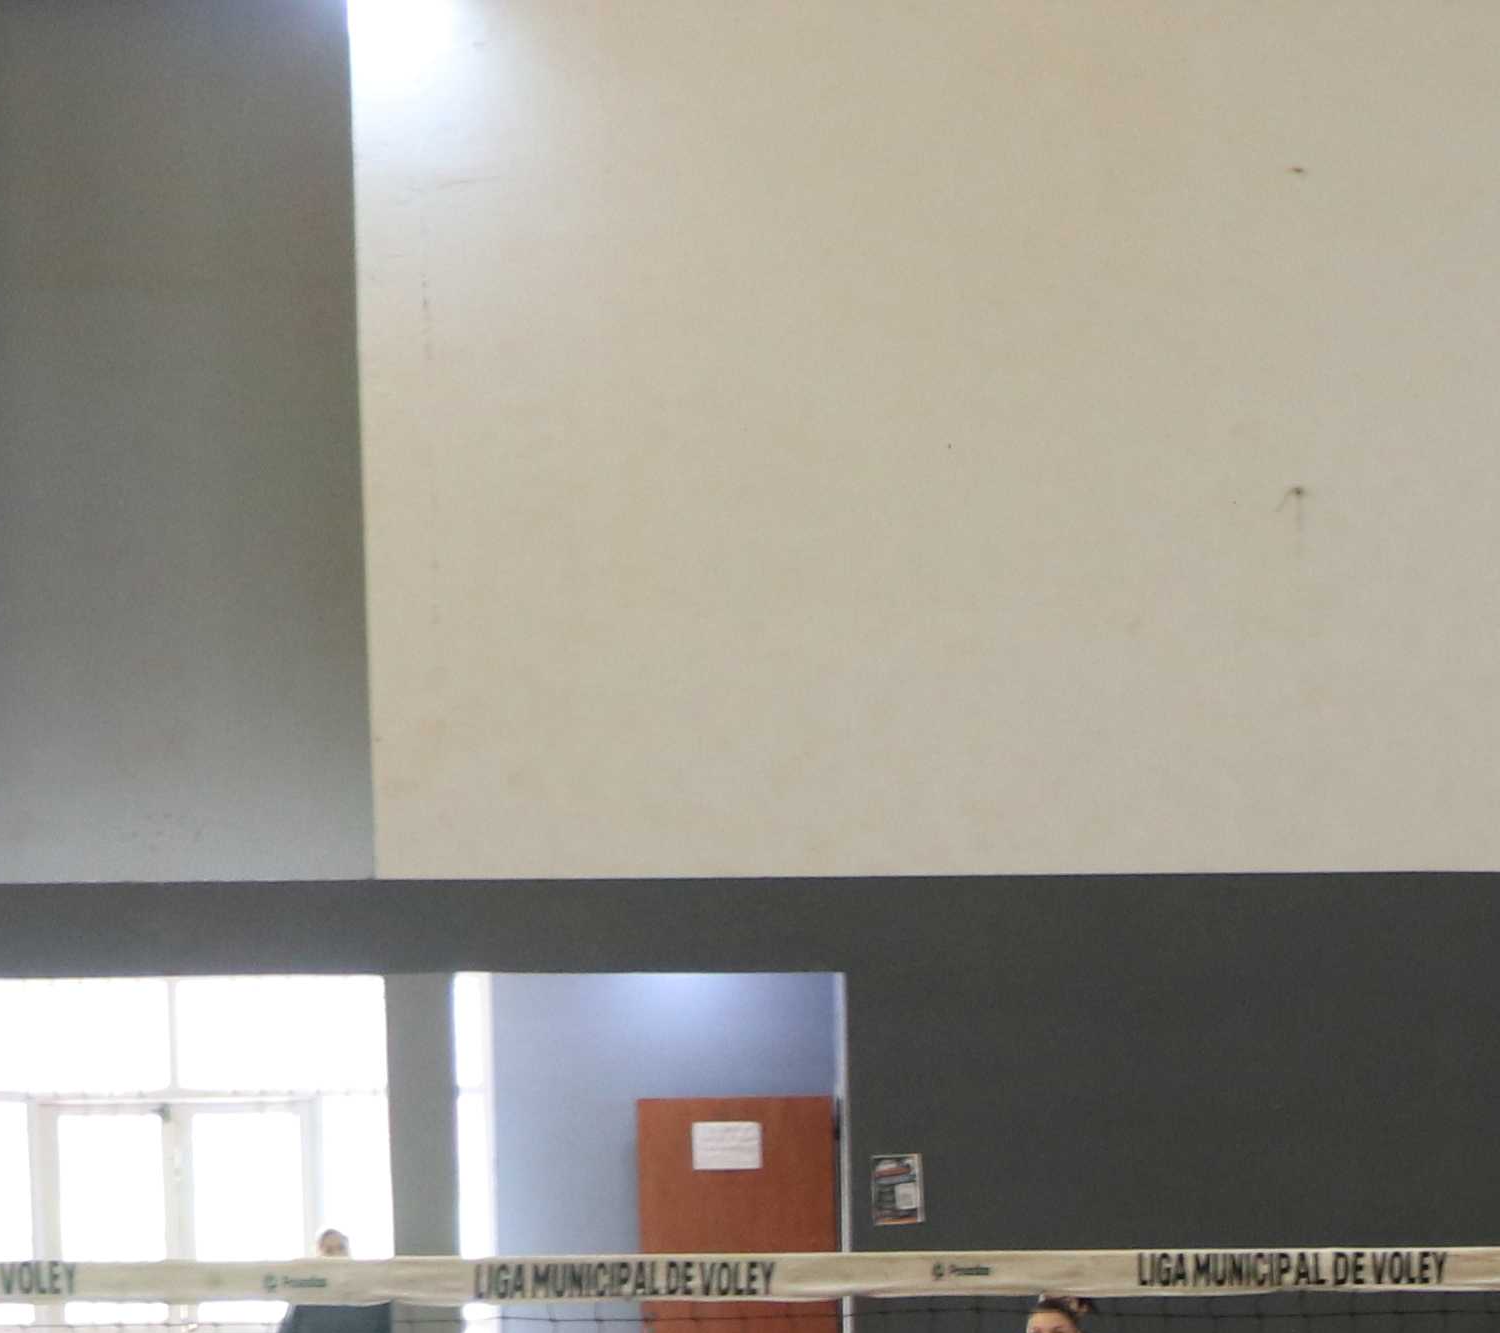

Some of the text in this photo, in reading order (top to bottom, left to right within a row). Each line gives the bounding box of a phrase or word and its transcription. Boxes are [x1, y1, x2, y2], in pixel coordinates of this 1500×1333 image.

[1, 1260, 77, 1295] VOLEY
[474, 1260, 777, 1299] LIGA MUNICIPAL DE VOLEY
[1136, 1250, 1449, 1287] LIGA MUNICIPAL DE VOLEY
